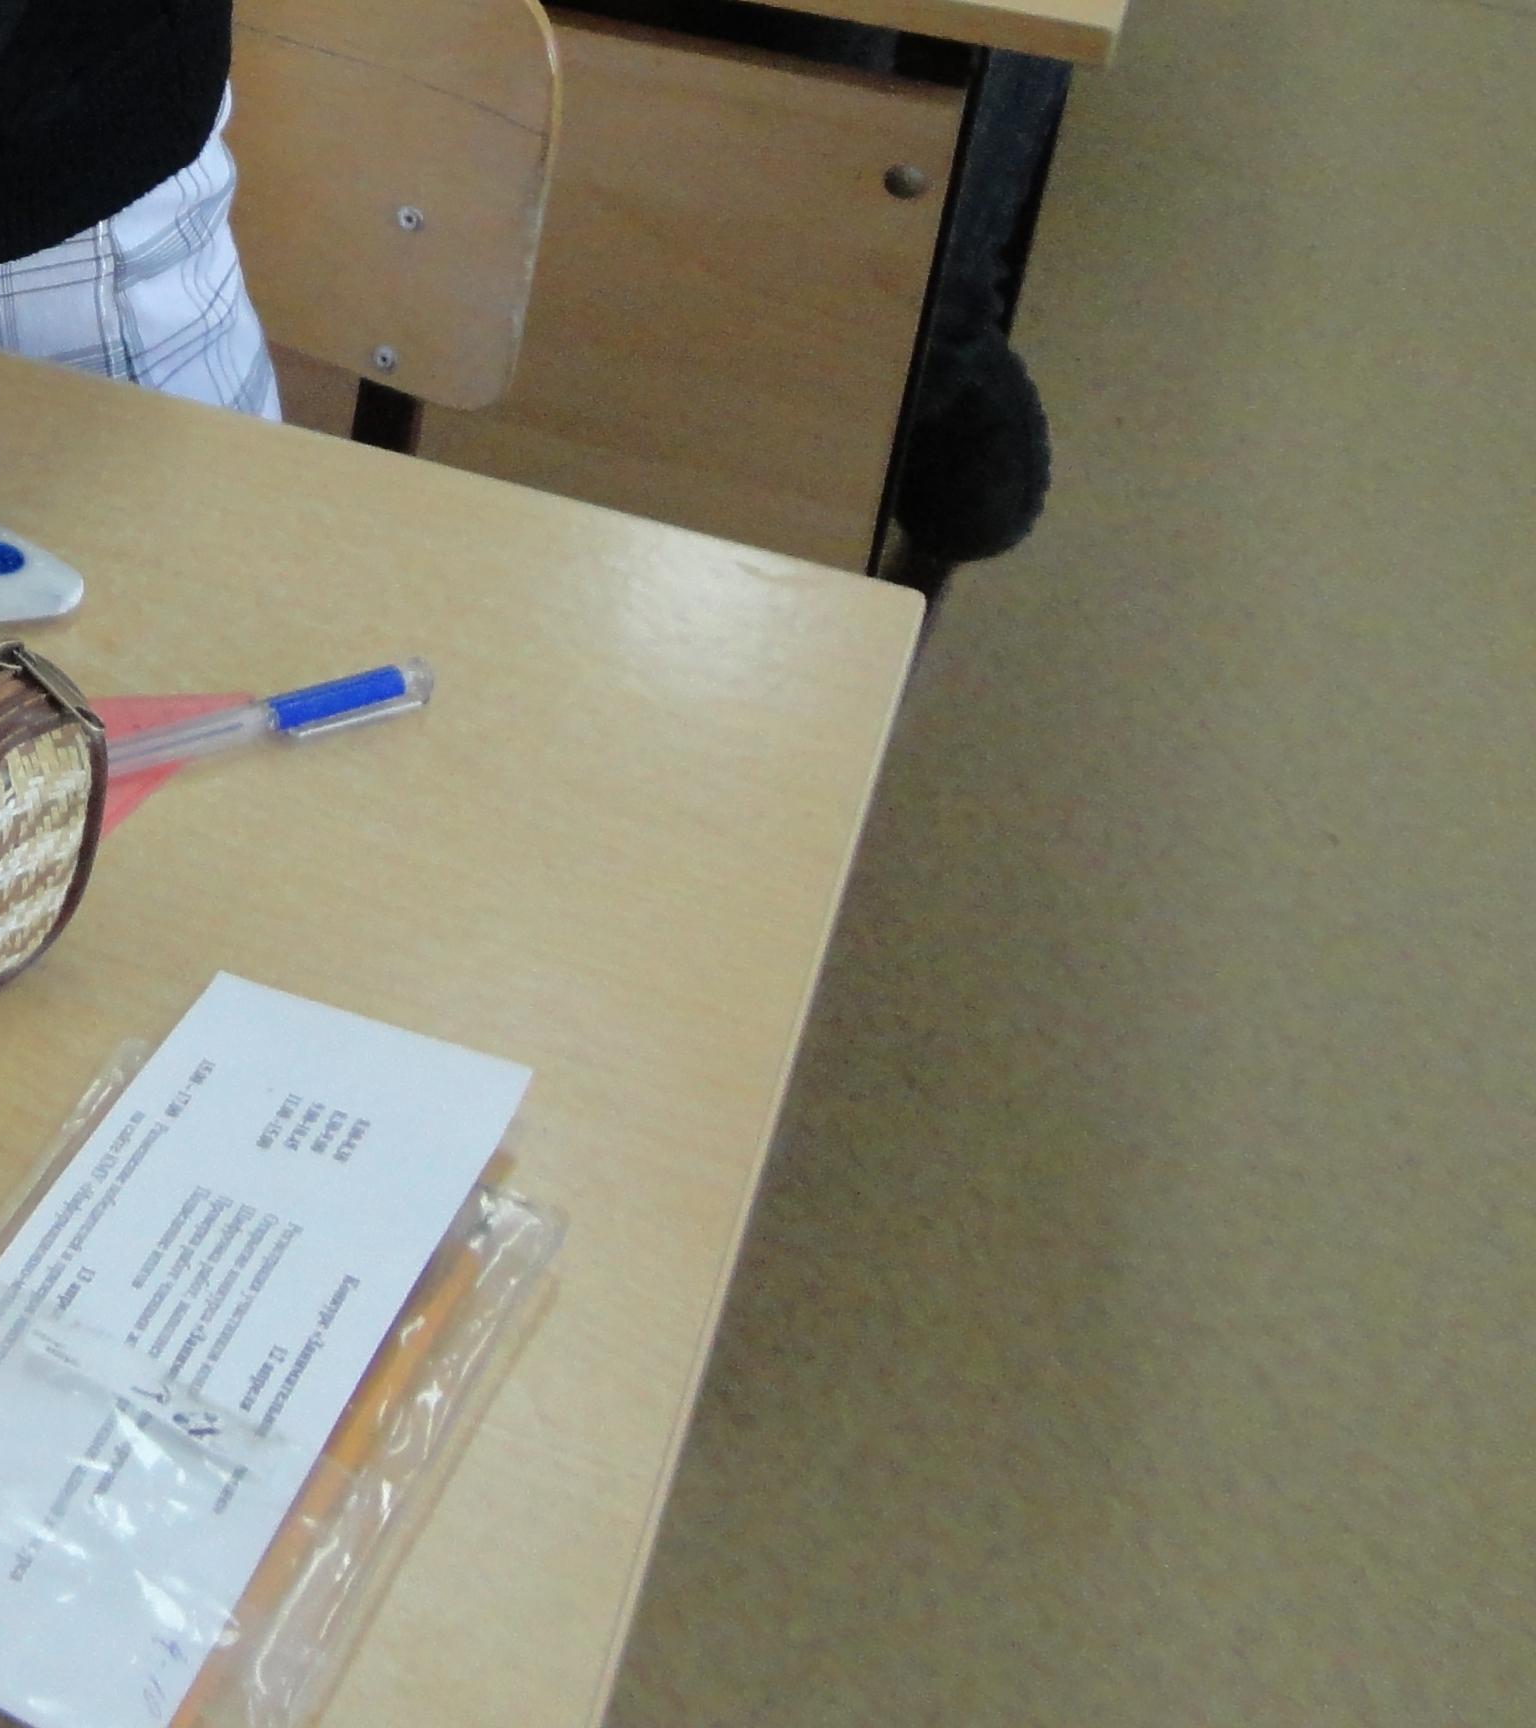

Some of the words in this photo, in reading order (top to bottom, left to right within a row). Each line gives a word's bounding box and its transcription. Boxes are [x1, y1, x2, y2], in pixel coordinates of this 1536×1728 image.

[155, 1185, 212, 1251] Подведение
[187, 1194, 235, 1247] Проверка
[232, 1211, 282, 1269] Открытие
[73, 1265, 98, 1284] 13
[129, 1249, 165, 1290] итогов
[166, 1244, 198, 1281] работ
[247, 1220, 306, 1292] Регистрация
[197, 1267, 241, 1322] конкурса
[311, 1274, 362, 1331] Конкурс
[204, 1289, 258, 1362] участников
[266, 1345, 289, 1363] 12
[235, 1359, 277, 1413] апреля
